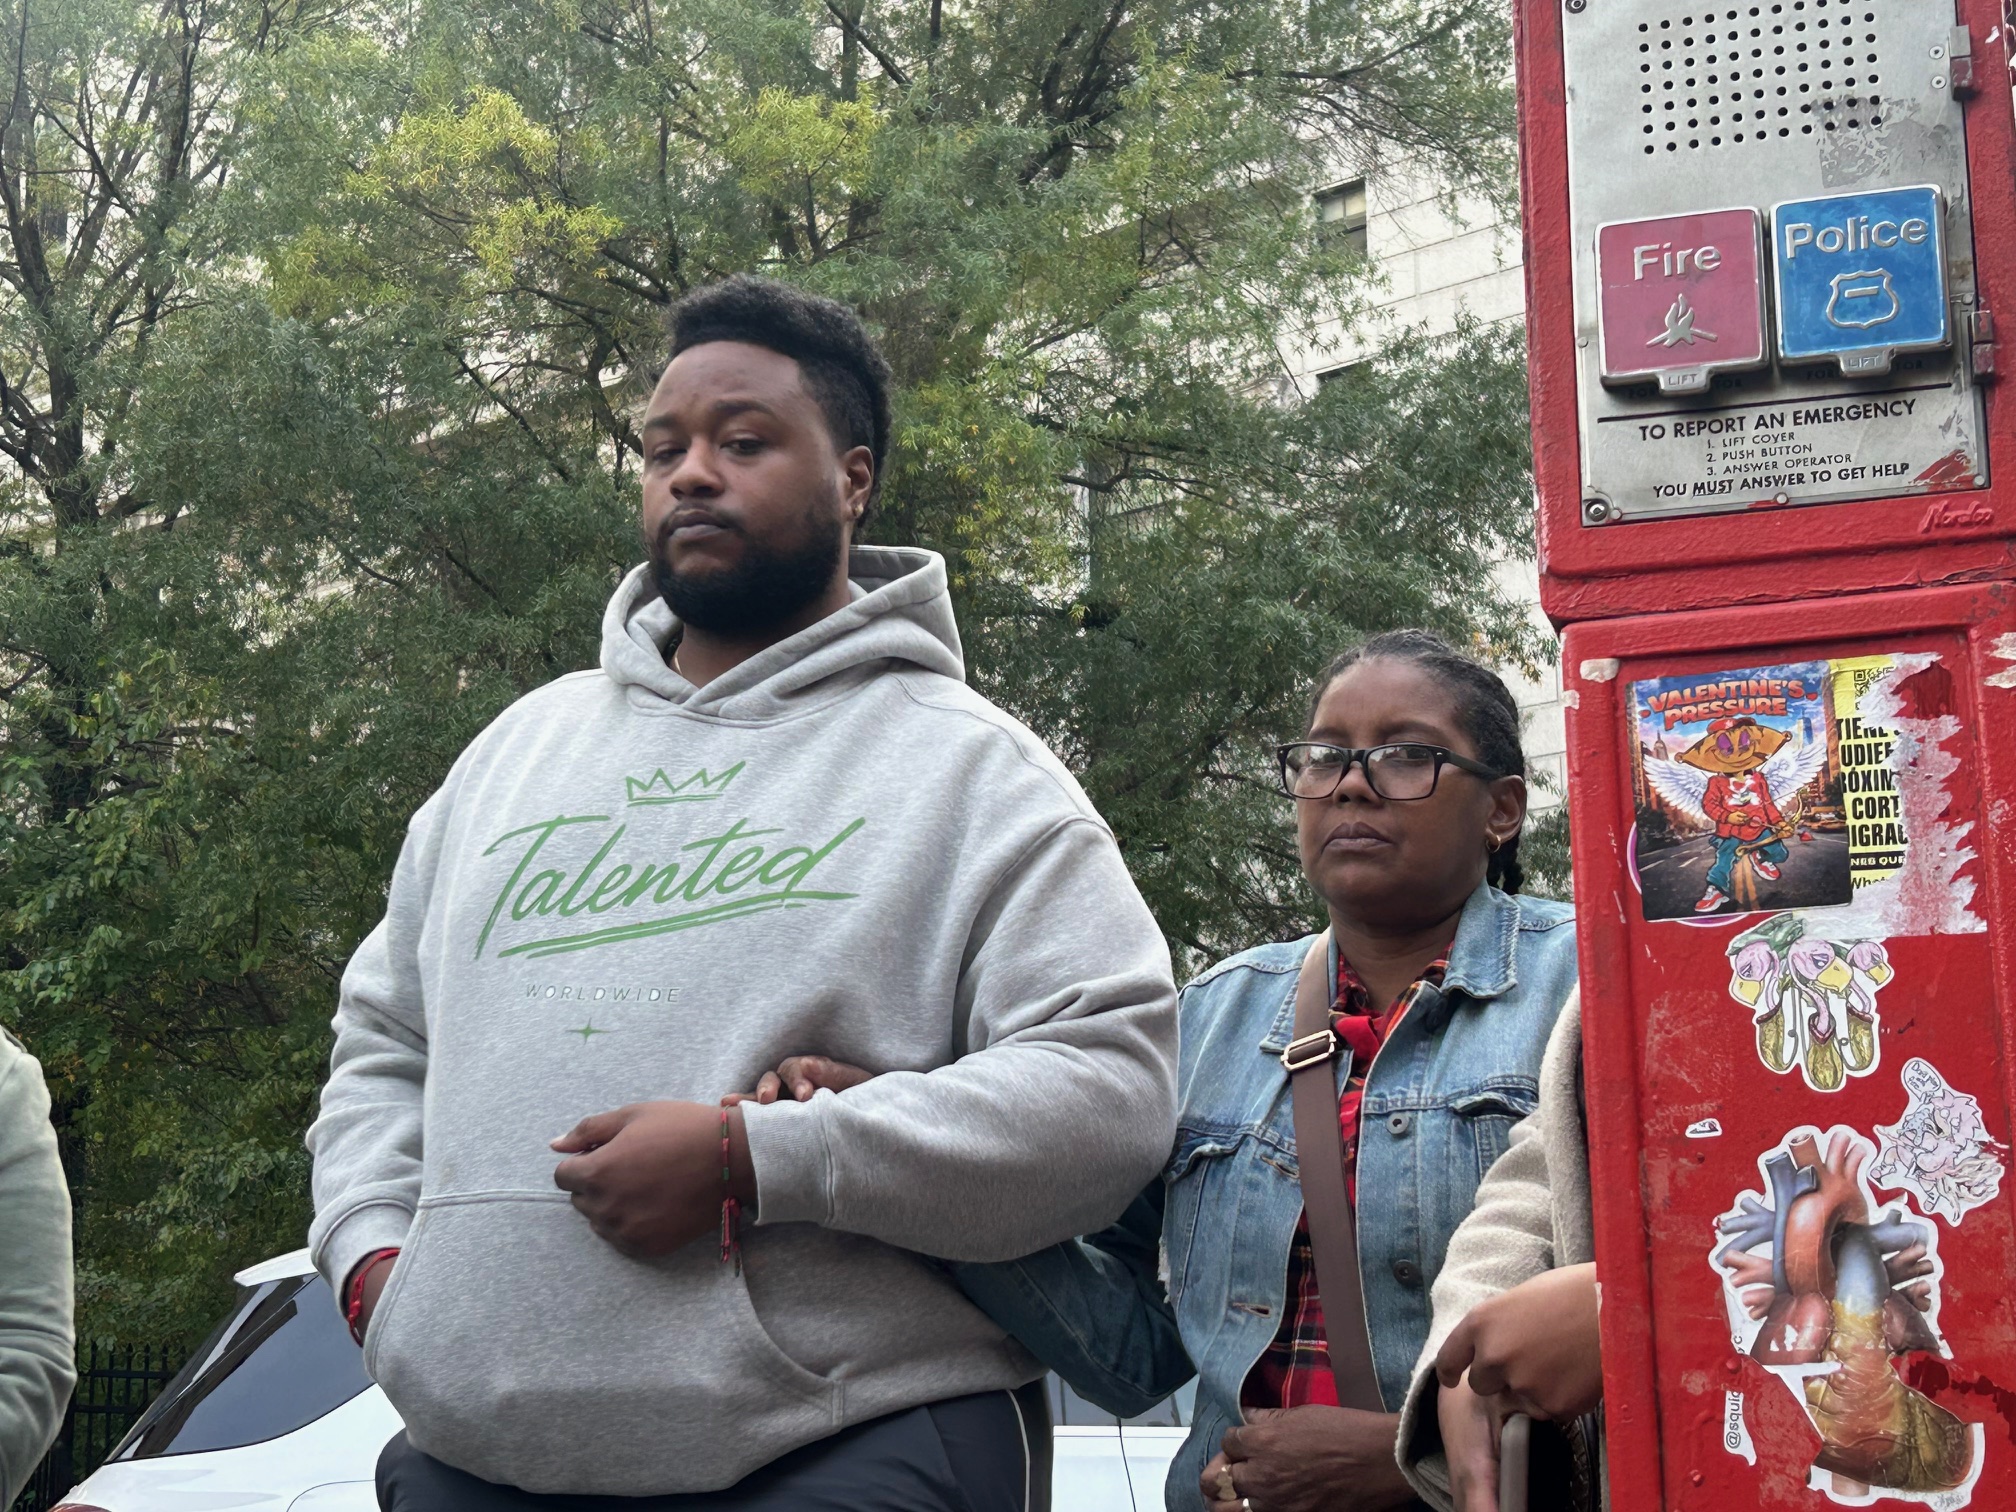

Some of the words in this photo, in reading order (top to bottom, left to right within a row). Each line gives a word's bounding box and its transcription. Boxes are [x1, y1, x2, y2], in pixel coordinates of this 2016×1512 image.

[1785, 216, 1929, 260] Police
[1633, 242, 1722, 281] Fire
[1849, 355, 1880, 368] LIFT
[1668, 373, 1698, 386] LIFT
[1639, 424, 1666, 441] TO
[1674, 416, 1746, 438] REPORT
[1754, 412, 1785, 430] AN
[1793, 398, 1916, 426] EMERGENCY
[1722, 436, 1746, 448] LIFT
[1752, 432, 1795, 445] COVER
[1722, 450, 1755, 461] PUSH
[1761, 443, 1813, 457] BUTTON
[1653, 483, 1687, 498] YOU
[1693, 479, 1734, 497] MUST
[1740, 473, 1805, 490] ANSWER
[1811, 470, 1831, 483] TO
[1837, 465, 1867, 480] GET
[1873, 462, 1910, 478] HELP
[1706, 466, 1717, 476] 3.
[1723, 461, 1779, 475] ANSWER
[1785, 453, 1852, 469] OPERATOR
[1648, 679, 1806, 713] VALENTINE'S
[1664, 697, 1788, 731] PRESSURE
[474, 814, 866, 960] Talented
[525, 983, 681, 1003] WORLDWIDE
